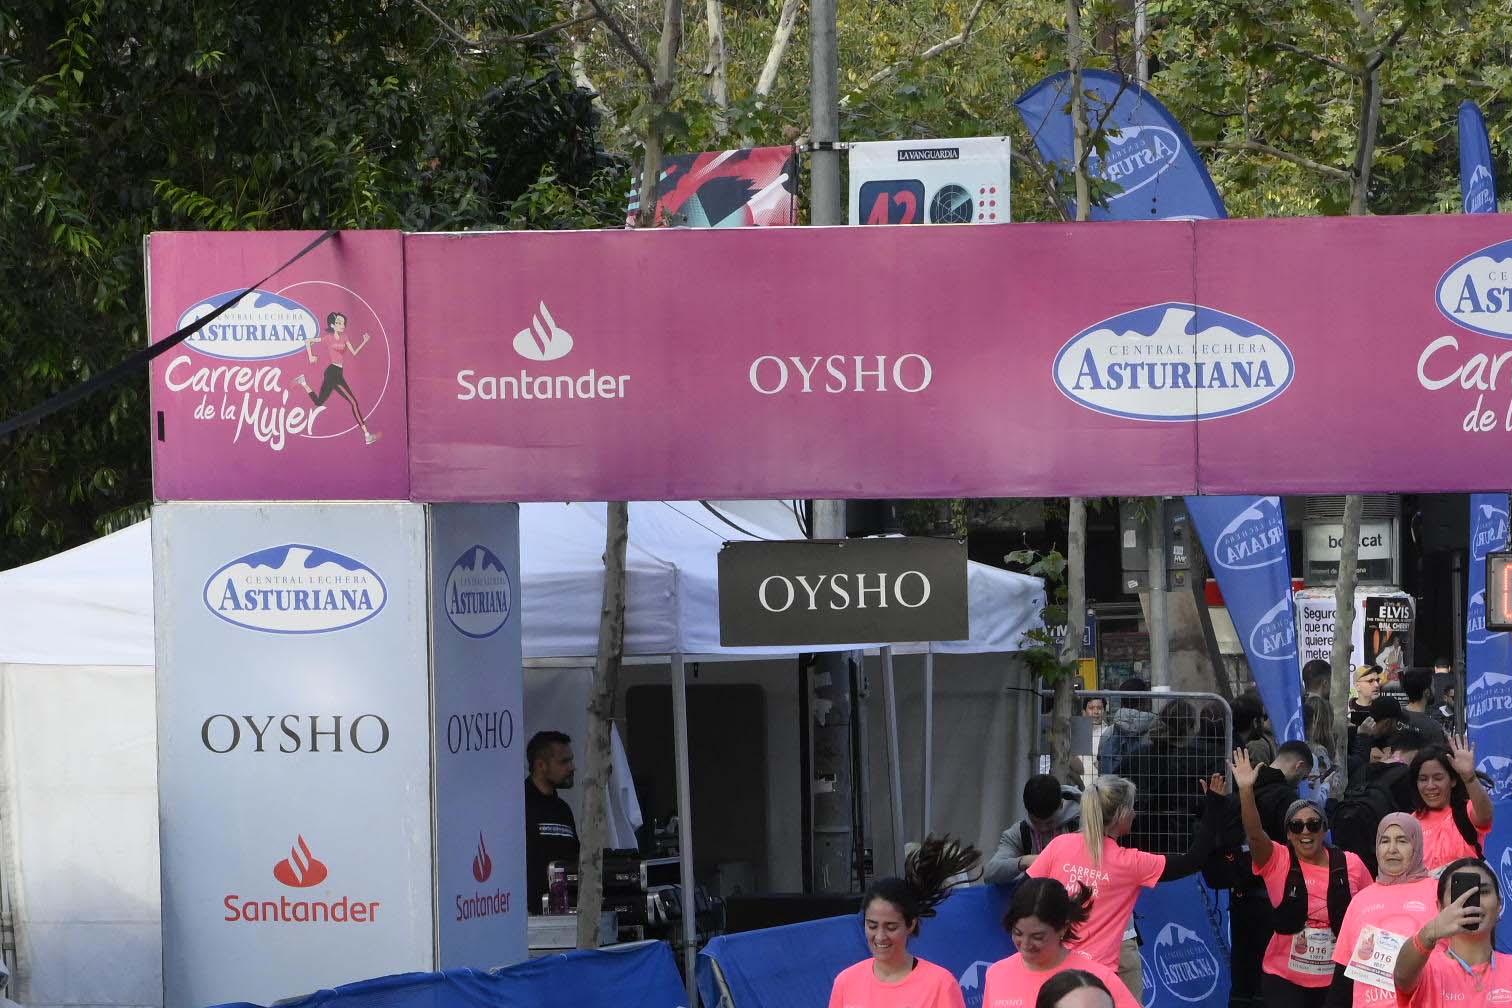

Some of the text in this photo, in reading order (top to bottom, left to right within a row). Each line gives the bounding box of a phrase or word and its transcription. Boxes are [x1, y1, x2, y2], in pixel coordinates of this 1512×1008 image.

[188, 315, 307, 342] ASTURIANA
[1108, 344, 1184, 355] CENTRAL
[165, 355, 281, 393] Carrera
[457, 368, 631, 400] Santander
[749, 353, 933, 394] OYSHO
[1072, 347, 1275, 391] ASTURIANA
[194, 389, 327, 451] de la Mujer
[1462, 393, 1498, 433] de
[218, 578, 374, 611] ASTURIANA
[246, 575, 368, 584] CENTRAL LECHERA
[758, 570, 931, 612] OYSHO
[450, 589, 508, 615] ASTURIANA
[1379, 606, 1409, 618] ELVIS
[1304, 623, 1320, 635] que
[201, 714, 390, 754] OYSHO
[447, 709, 514, 754] OYSHO
[1063, 863, 1110, 881] CARRERA
[224, 895, 380, 923] Santander
[456, 888, 511, 922] Santander
[1308, 946, 1327, 955] 016
[1374, 951, 1392, 963] 016
